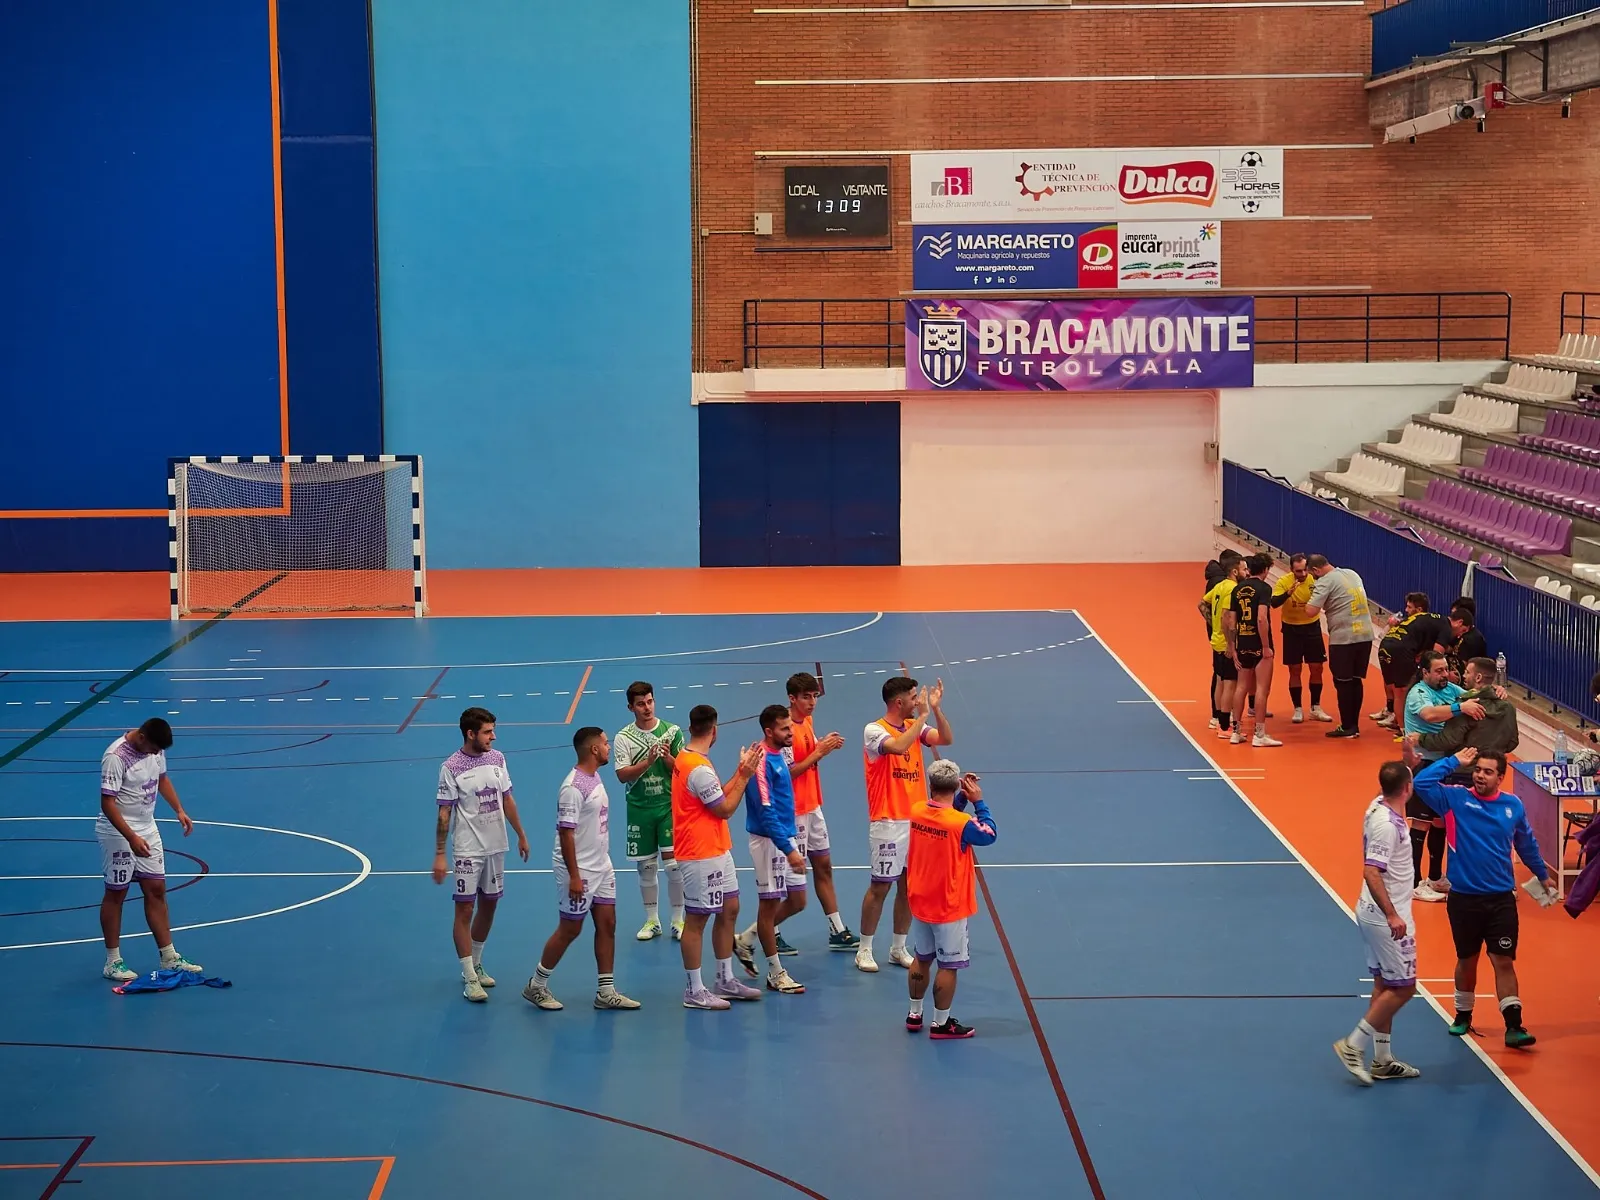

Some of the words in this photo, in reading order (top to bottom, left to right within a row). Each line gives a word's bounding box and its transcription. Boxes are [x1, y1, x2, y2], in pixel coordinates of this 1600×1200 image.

[1033, 163, 1076, 171] ENTIDAD
[1042, 173, 1085, 182] TÉCNICA
[1086, 173, 1100, 181] DE
[1123, 168, 1208, 194] Dulca
[1221, 168, 1258, 183] 32
[788, 185, 820, 196] LOCAL
[843, 184, 888, 196] VISITANTE
[1054, 183, 1117, 193] PREVENCIÓN
[1234, 182, 1280, 191] HORAS
[915, 199, 945, 209] cauchos
[957, 233, 1075, 250] MARGARETO
[1125, 233, 1157, 242] imprenta
[1121, 236, 1201, 257] eucarprint
[957, 252, 990, 260] Maquinaria
[1015, 252, 1020, 260] y
[1021, 251, 1051, 260] repuestos
[955, 264, 1035, 273] www.margareto.com
[978, 314, 1250, 356] BRACAMONTE
[978, 357, 1102, 376] FÚTBOL
[1121, 357, 1203, 376] SALA
[1213, 594, 1220, 616] 7
[1238, 598, 1252, 621] 15
[1542, 765, 1562, 778] 5
[1558, 778, 1577, 792] 5
[627, 841, 638, 856] 13
[878, 861, 893, 875] 17
[112, 869, 127, 884] 16
[456, 878, 466, 894] 9
[569, 897, 587, 913] 92
[707, 890, 723, 906] 19
